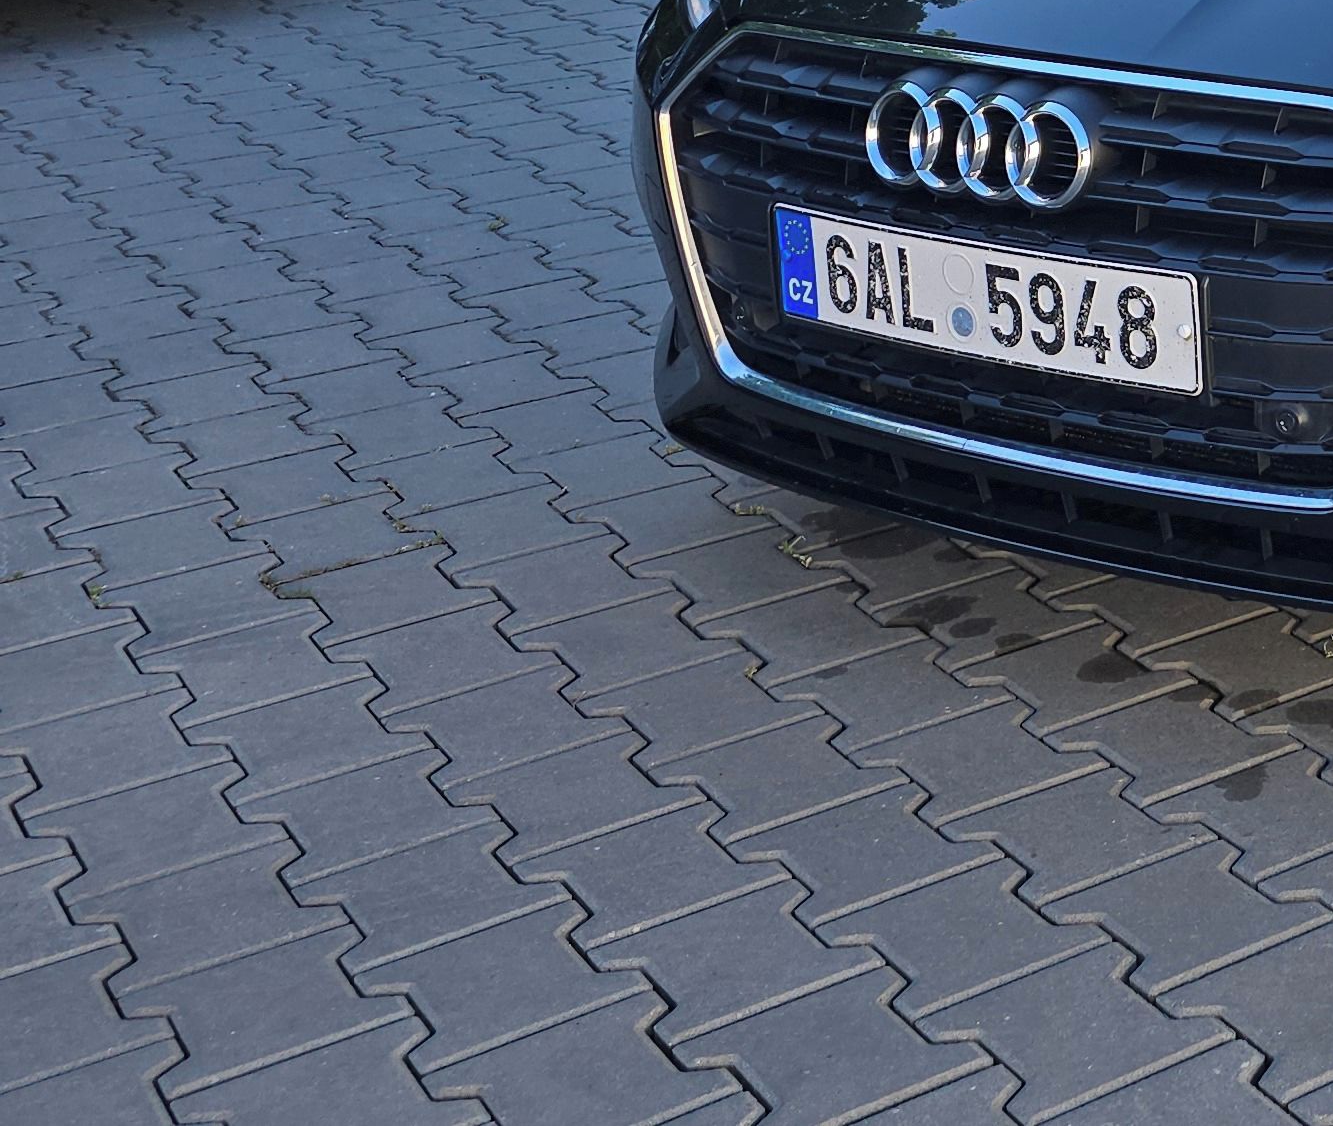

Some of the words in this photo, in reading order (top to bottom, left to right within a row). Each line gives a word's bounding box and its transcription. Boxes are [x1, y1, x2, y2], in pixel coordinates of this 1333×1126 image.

[788, 277, 814, 305] CZ
[826, 235, 934, 333] 6AL
[985, 263, 1158, 370] 5948
